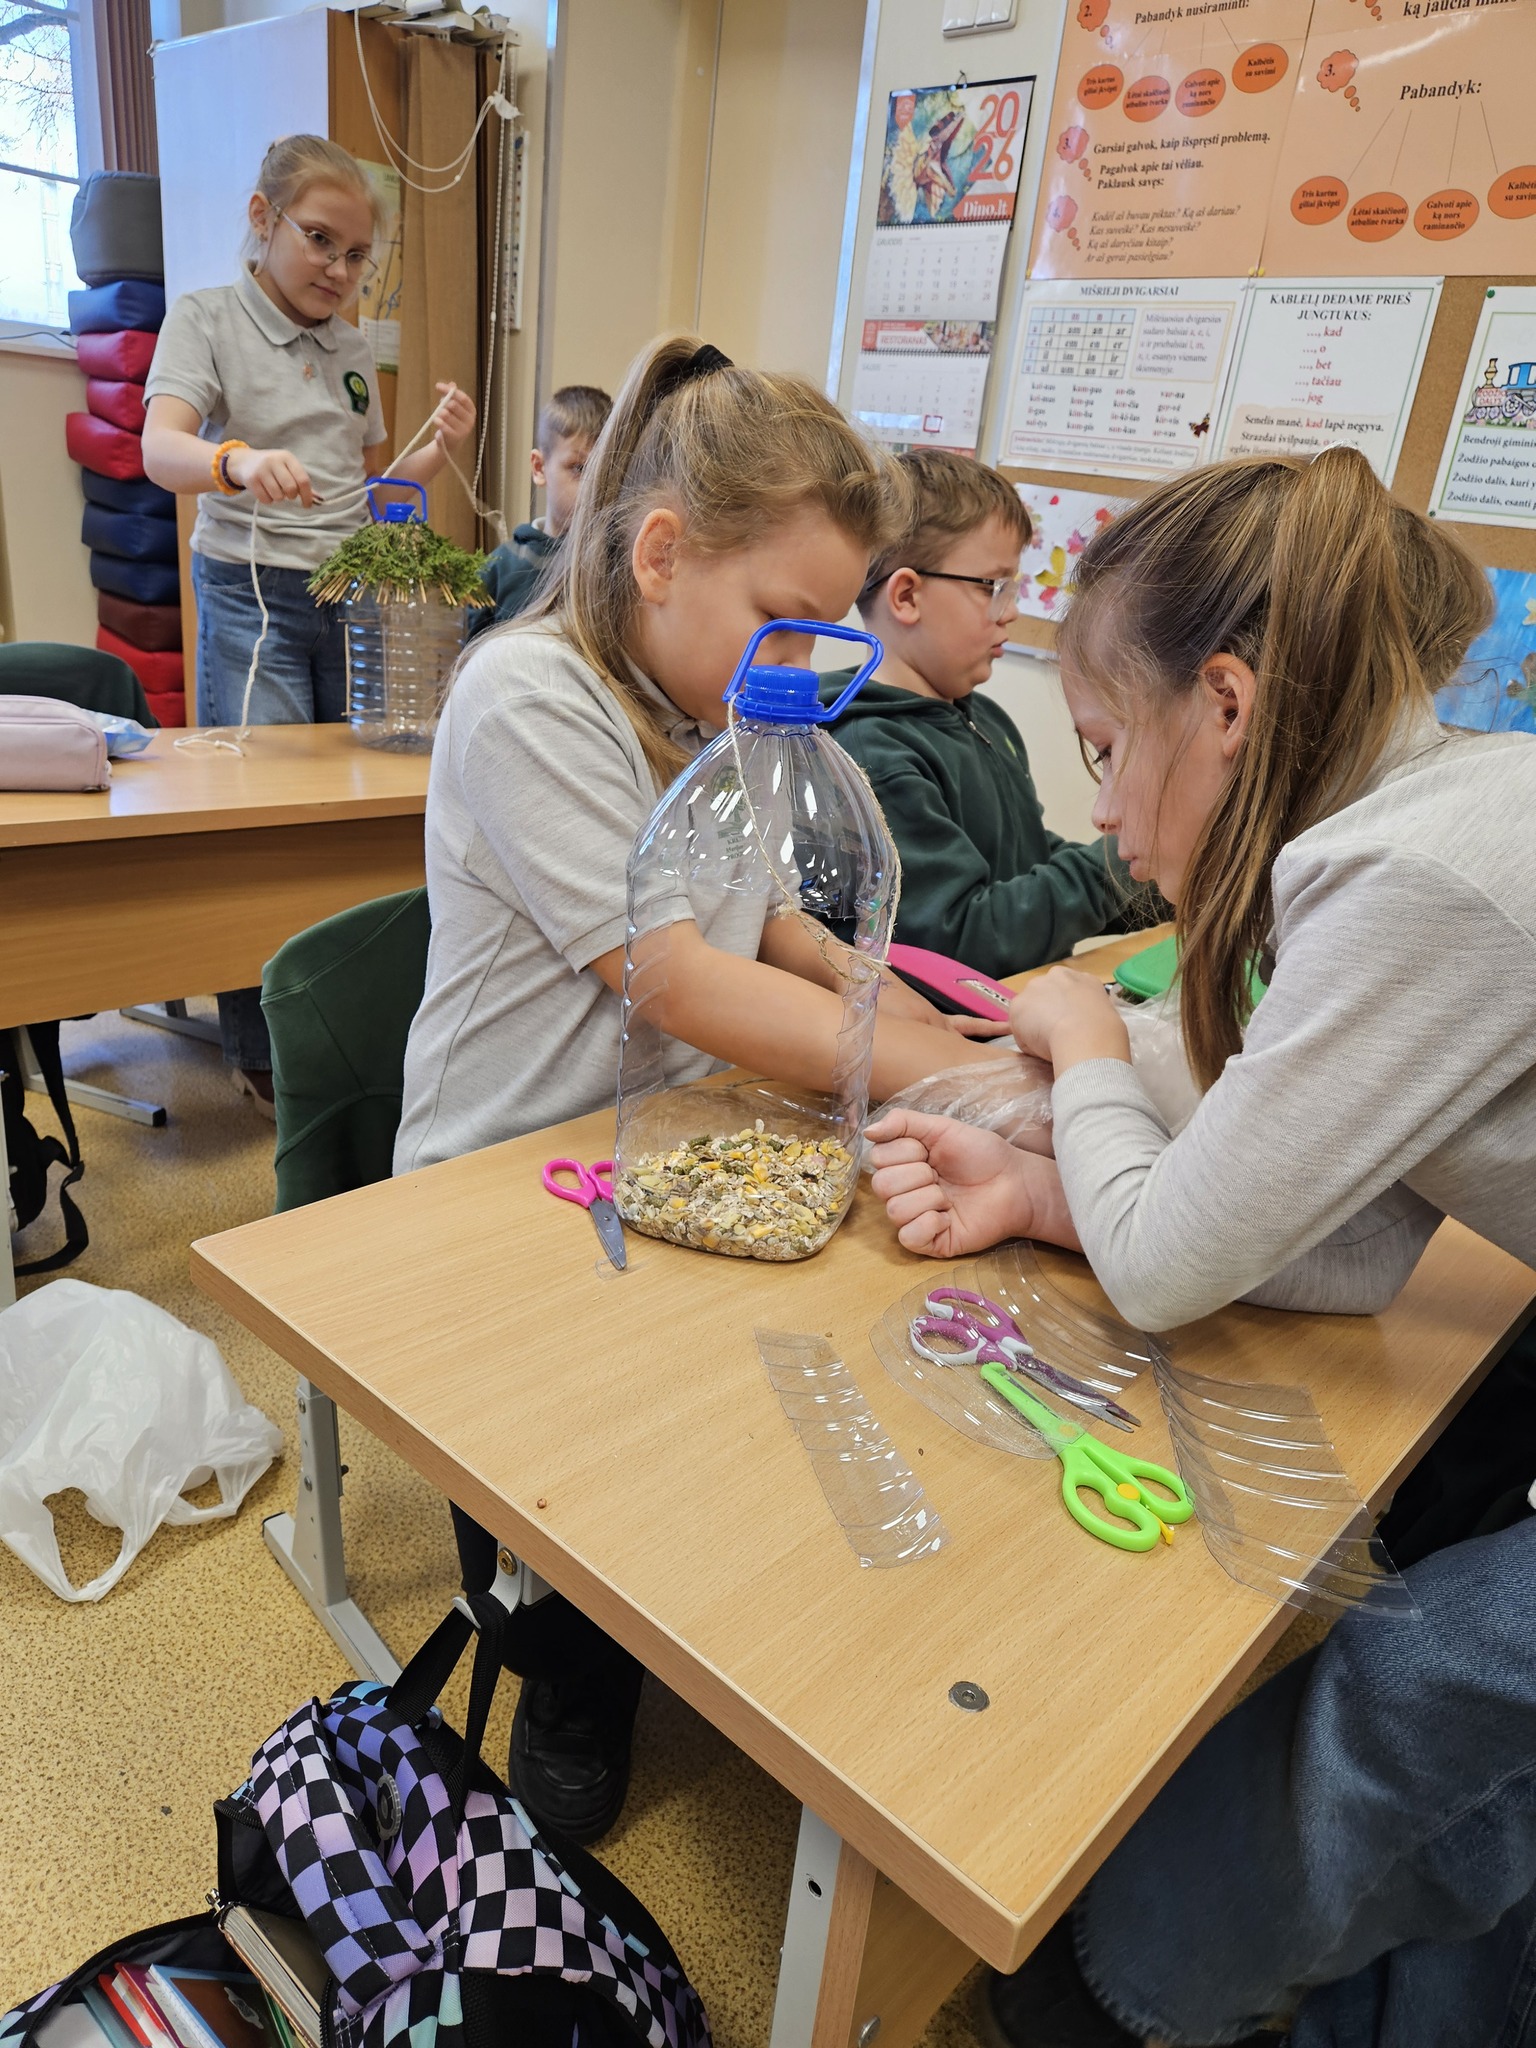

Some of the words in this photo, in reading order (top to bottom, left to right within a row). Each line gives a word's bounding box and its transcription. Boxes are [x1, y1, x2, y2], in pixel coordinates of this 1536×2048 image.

[1084, 5, 1092, 17] 2.
[1135, 6, 1183, 24] Pabandyk
[1186, 0, 1250, 16] nusiraminti:
[1403, 1, 1420, 18] ką
[1254, 68, 1276, 76] savimi
[1325, 64, 1336, 77] 3.
[1400, 80, 1482, 100] Pabandyk:
[975, 91, 1020, 138] 20
[1063, 138, 1072, 150] 3.
[1094, 143, 1126, 154] Garsiai
[1126, 140, 1158, 154] galvok,
[1160, 138, 1180, 151] kaip
[1182, 134, 1220, 148] išspręsti
[1220, 131, 1270, 147] problemą.
[968, 129, 1017, 182] 26
[1100, 161, 1138, 176] Pagalvok
[1140, 160, 1158, 174] apie
[1161, 160, 1173, 171] tai
[1175, 158, 1204, 170] vėliau.
[1098, 176, 1136, 189] Paklausk
[1302, 190, 1314, 198] Tris
[963, 199, 1009, 218] Dino.lt
[1298, 200, 1316, 210] giliai
[1353, 208, 1372, 216] Lėtai
[1372, 206, 1408, 215] skaičiuoti
[1426, 200, 1454, 210] Galvoti
[1456, 200, 1472, 210] apie
[1351, 218, 1380, 226] atbuline
[1432, 212, 1442, 220] ką
[1423, 222, 1466, 230] raminančio
[1080, 286, 1120, 296] MIŠRIEJI
[1122, 286, 1180, 296] DVIGARSIAI
[1270, 294, 1320, 307] KABLELĮ
[1322, 294, 1373, 305] DEDAME
[1376, 292, 1413, 305] PRIEŠ
[1297, 310, 1372, 320] JUNGTUKUS:
[1324, 326, 1343, 337] kad
[1320, 345, 1326, 353] o
[1316, 359, 1332, 370] bet
[1312, 376, 1342, 386] tačiau
[1307, 392, 1324, 404] jog
[1245, 414, 1274, 426] Senelis
[1305, 418, 1324, 429] kad
[1324, 420, 1346, 434] lapė
[1347, 422, 1384, 434] negyva.
[1242, 432, 1276, 442] Strazdai
[1463, 434, 1502, 447] Bendroji
[1458, 452, 1488, 464] Žodžio
[1490, 456, 1530, 469] pabaigos
[1452, 472, 1483, 484] Žodžio
[1484, 476, 1508, 486] dalis,
[1510, 477, 1530, 488] kuri
[1447, 491, 1478, 502] Žodžio
[1480, 494, 1502, 506] dalis,
[1504, 498, 1531, 508] esanti
